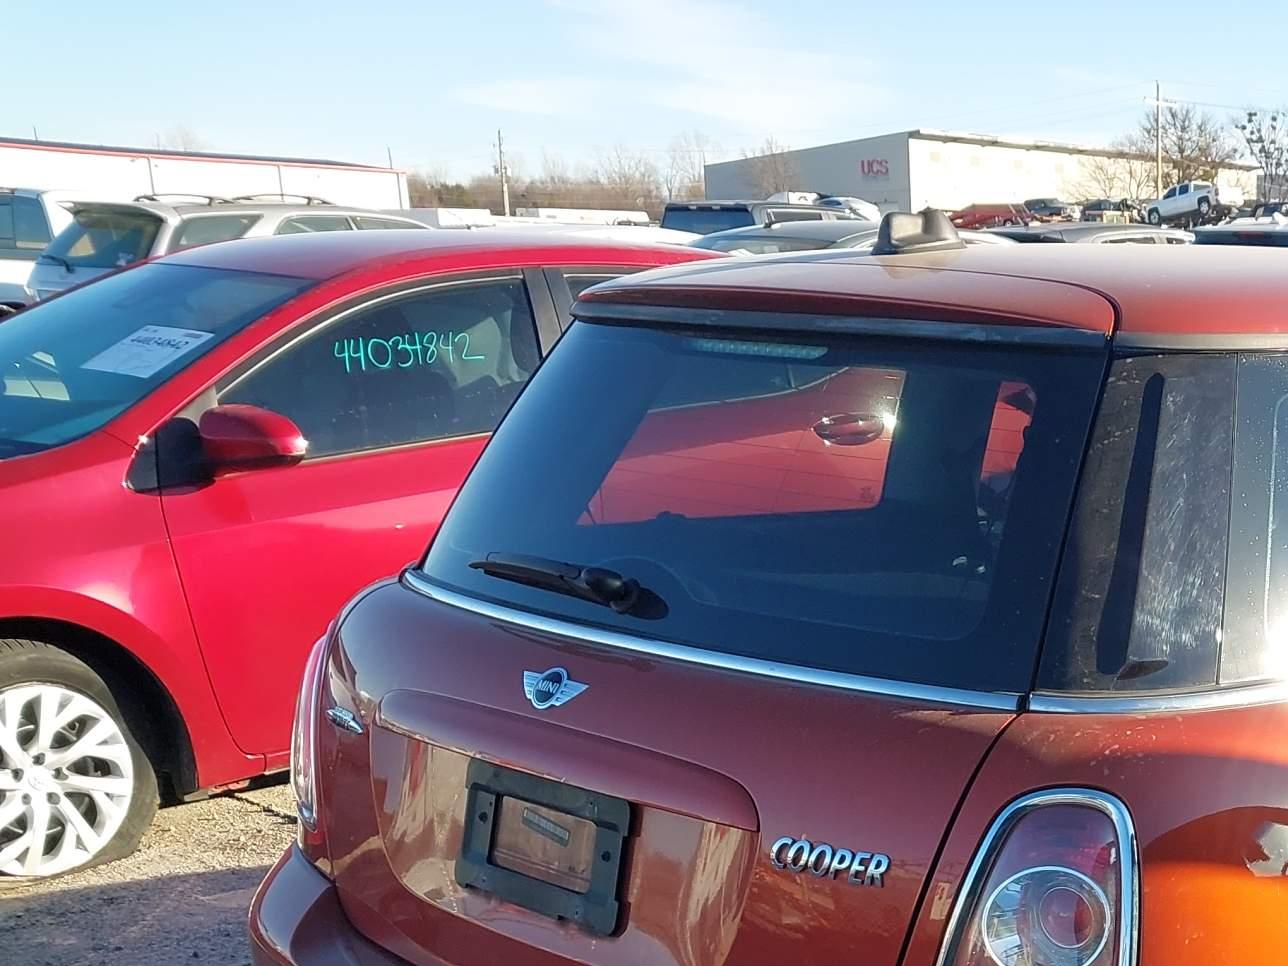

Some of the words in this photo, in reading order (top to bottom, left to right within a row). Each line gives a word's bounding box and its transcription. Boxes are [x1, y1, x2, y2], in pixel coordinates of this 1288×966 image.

[861, 159, 889, 176] UCS
[334, 331, 485, 373] 44034842
[538, 679, 560, 694] MINI
[770, 836, 891, 888] COOPER
